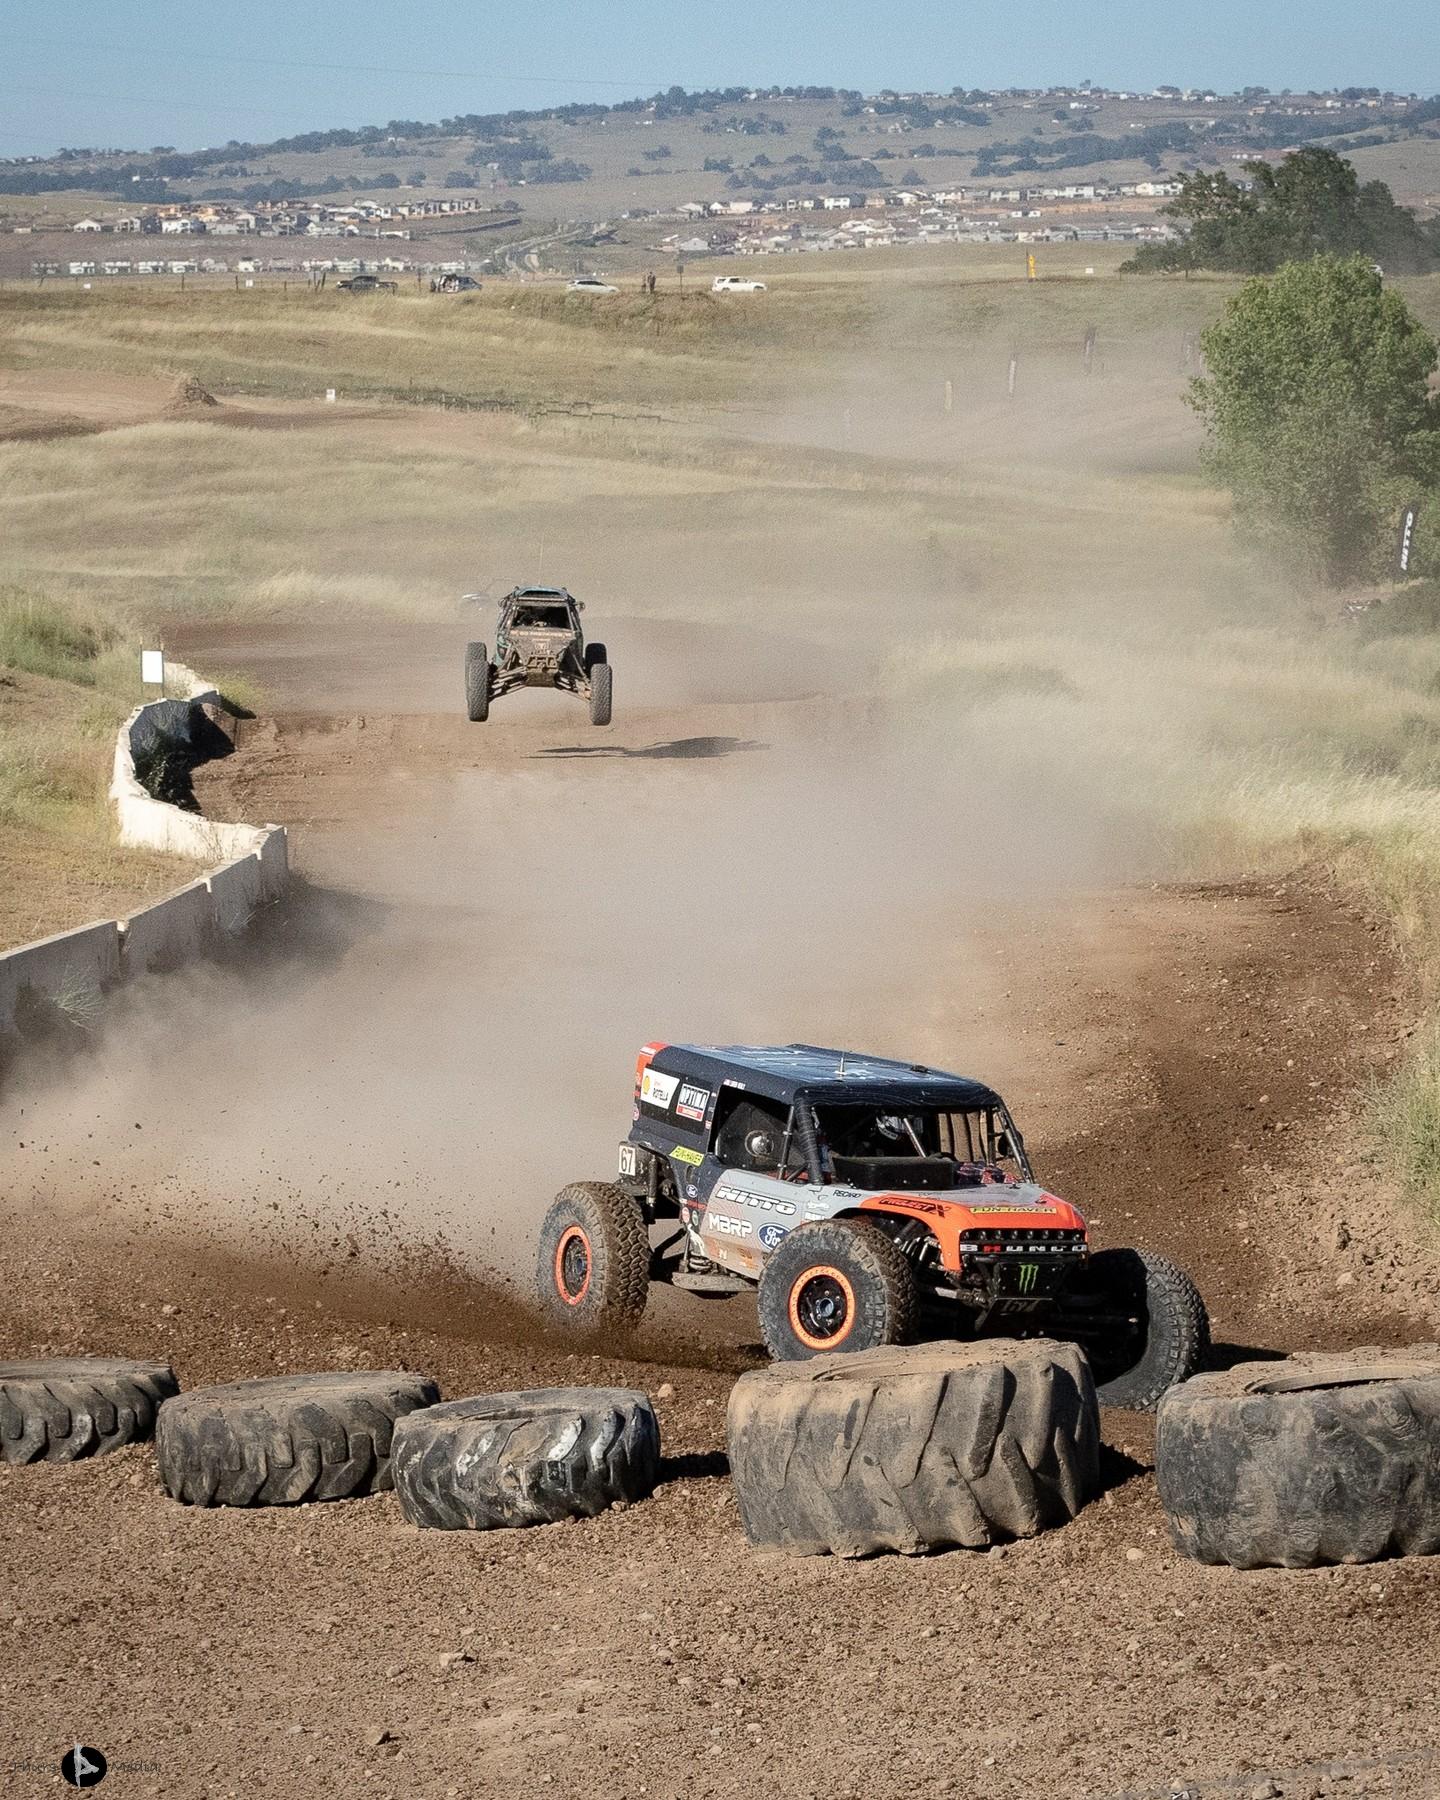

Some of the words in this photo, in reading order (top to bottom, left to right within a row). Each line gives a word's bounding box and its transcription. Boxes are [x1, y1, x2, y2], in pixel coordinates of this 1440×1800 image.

[620, 1147, 634, 1173] 67
[715, 1185, 798, 1216] NITTO
[708, 1212, 753, 1238] MBRP
[764, 1226, 785, 1247] Fo
